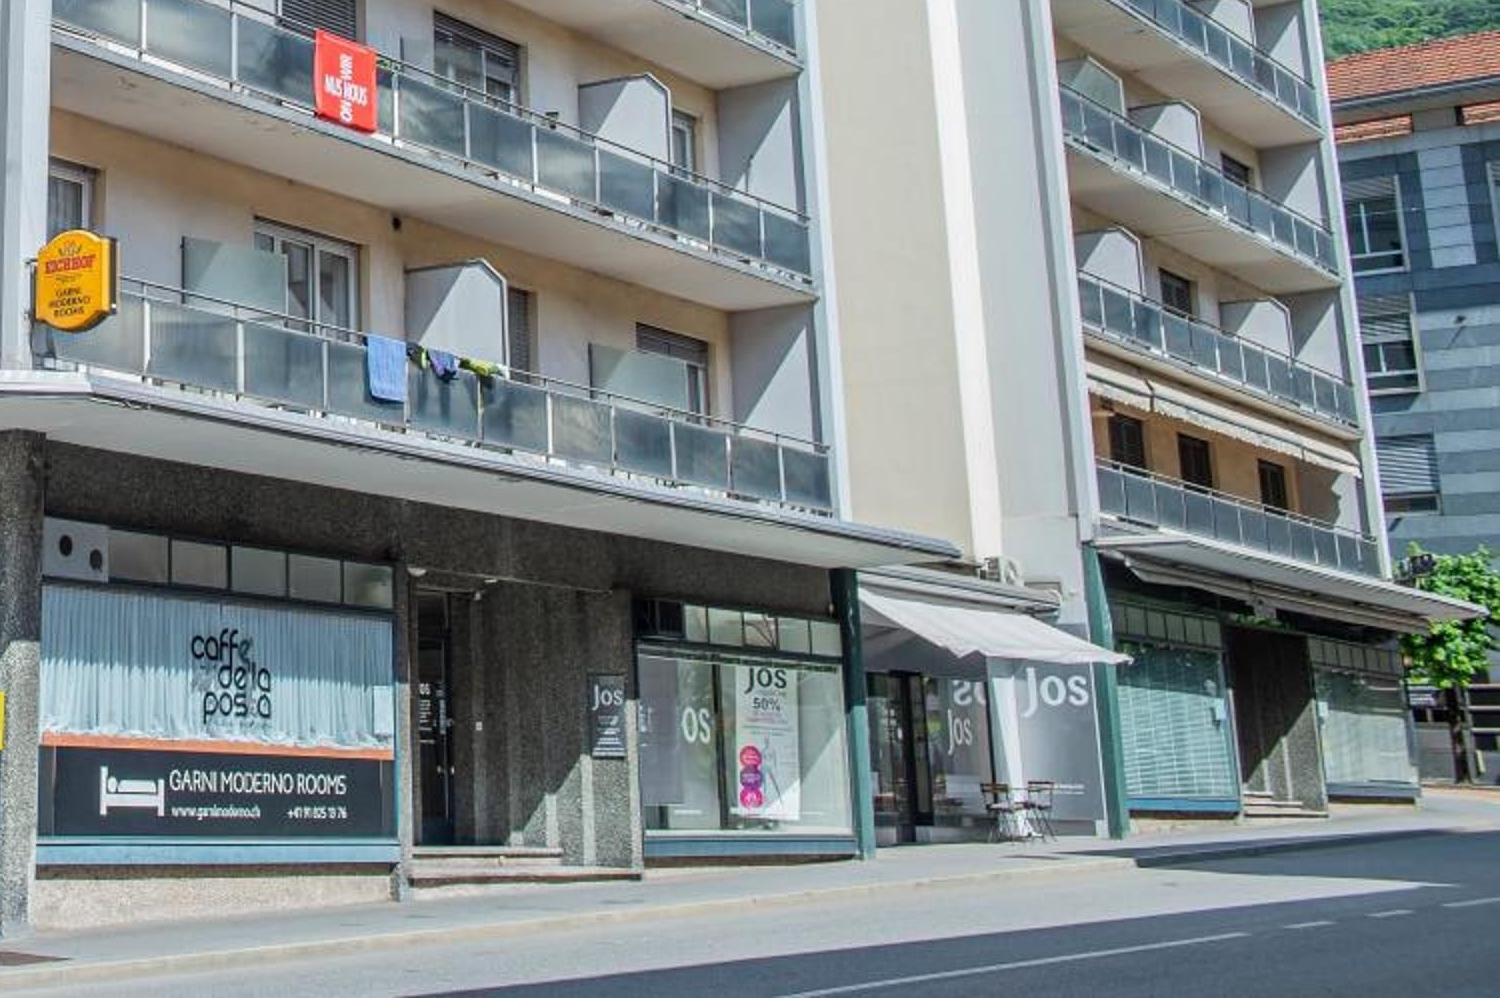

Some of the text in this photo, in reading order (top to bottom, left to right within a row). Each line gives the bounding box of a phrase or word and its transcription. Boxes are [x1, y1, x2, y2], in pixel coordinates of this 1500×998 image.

[753, 697, 781, 712] 50%
[169, 769, 348, 795] GARNI MODERNO ROOMS
